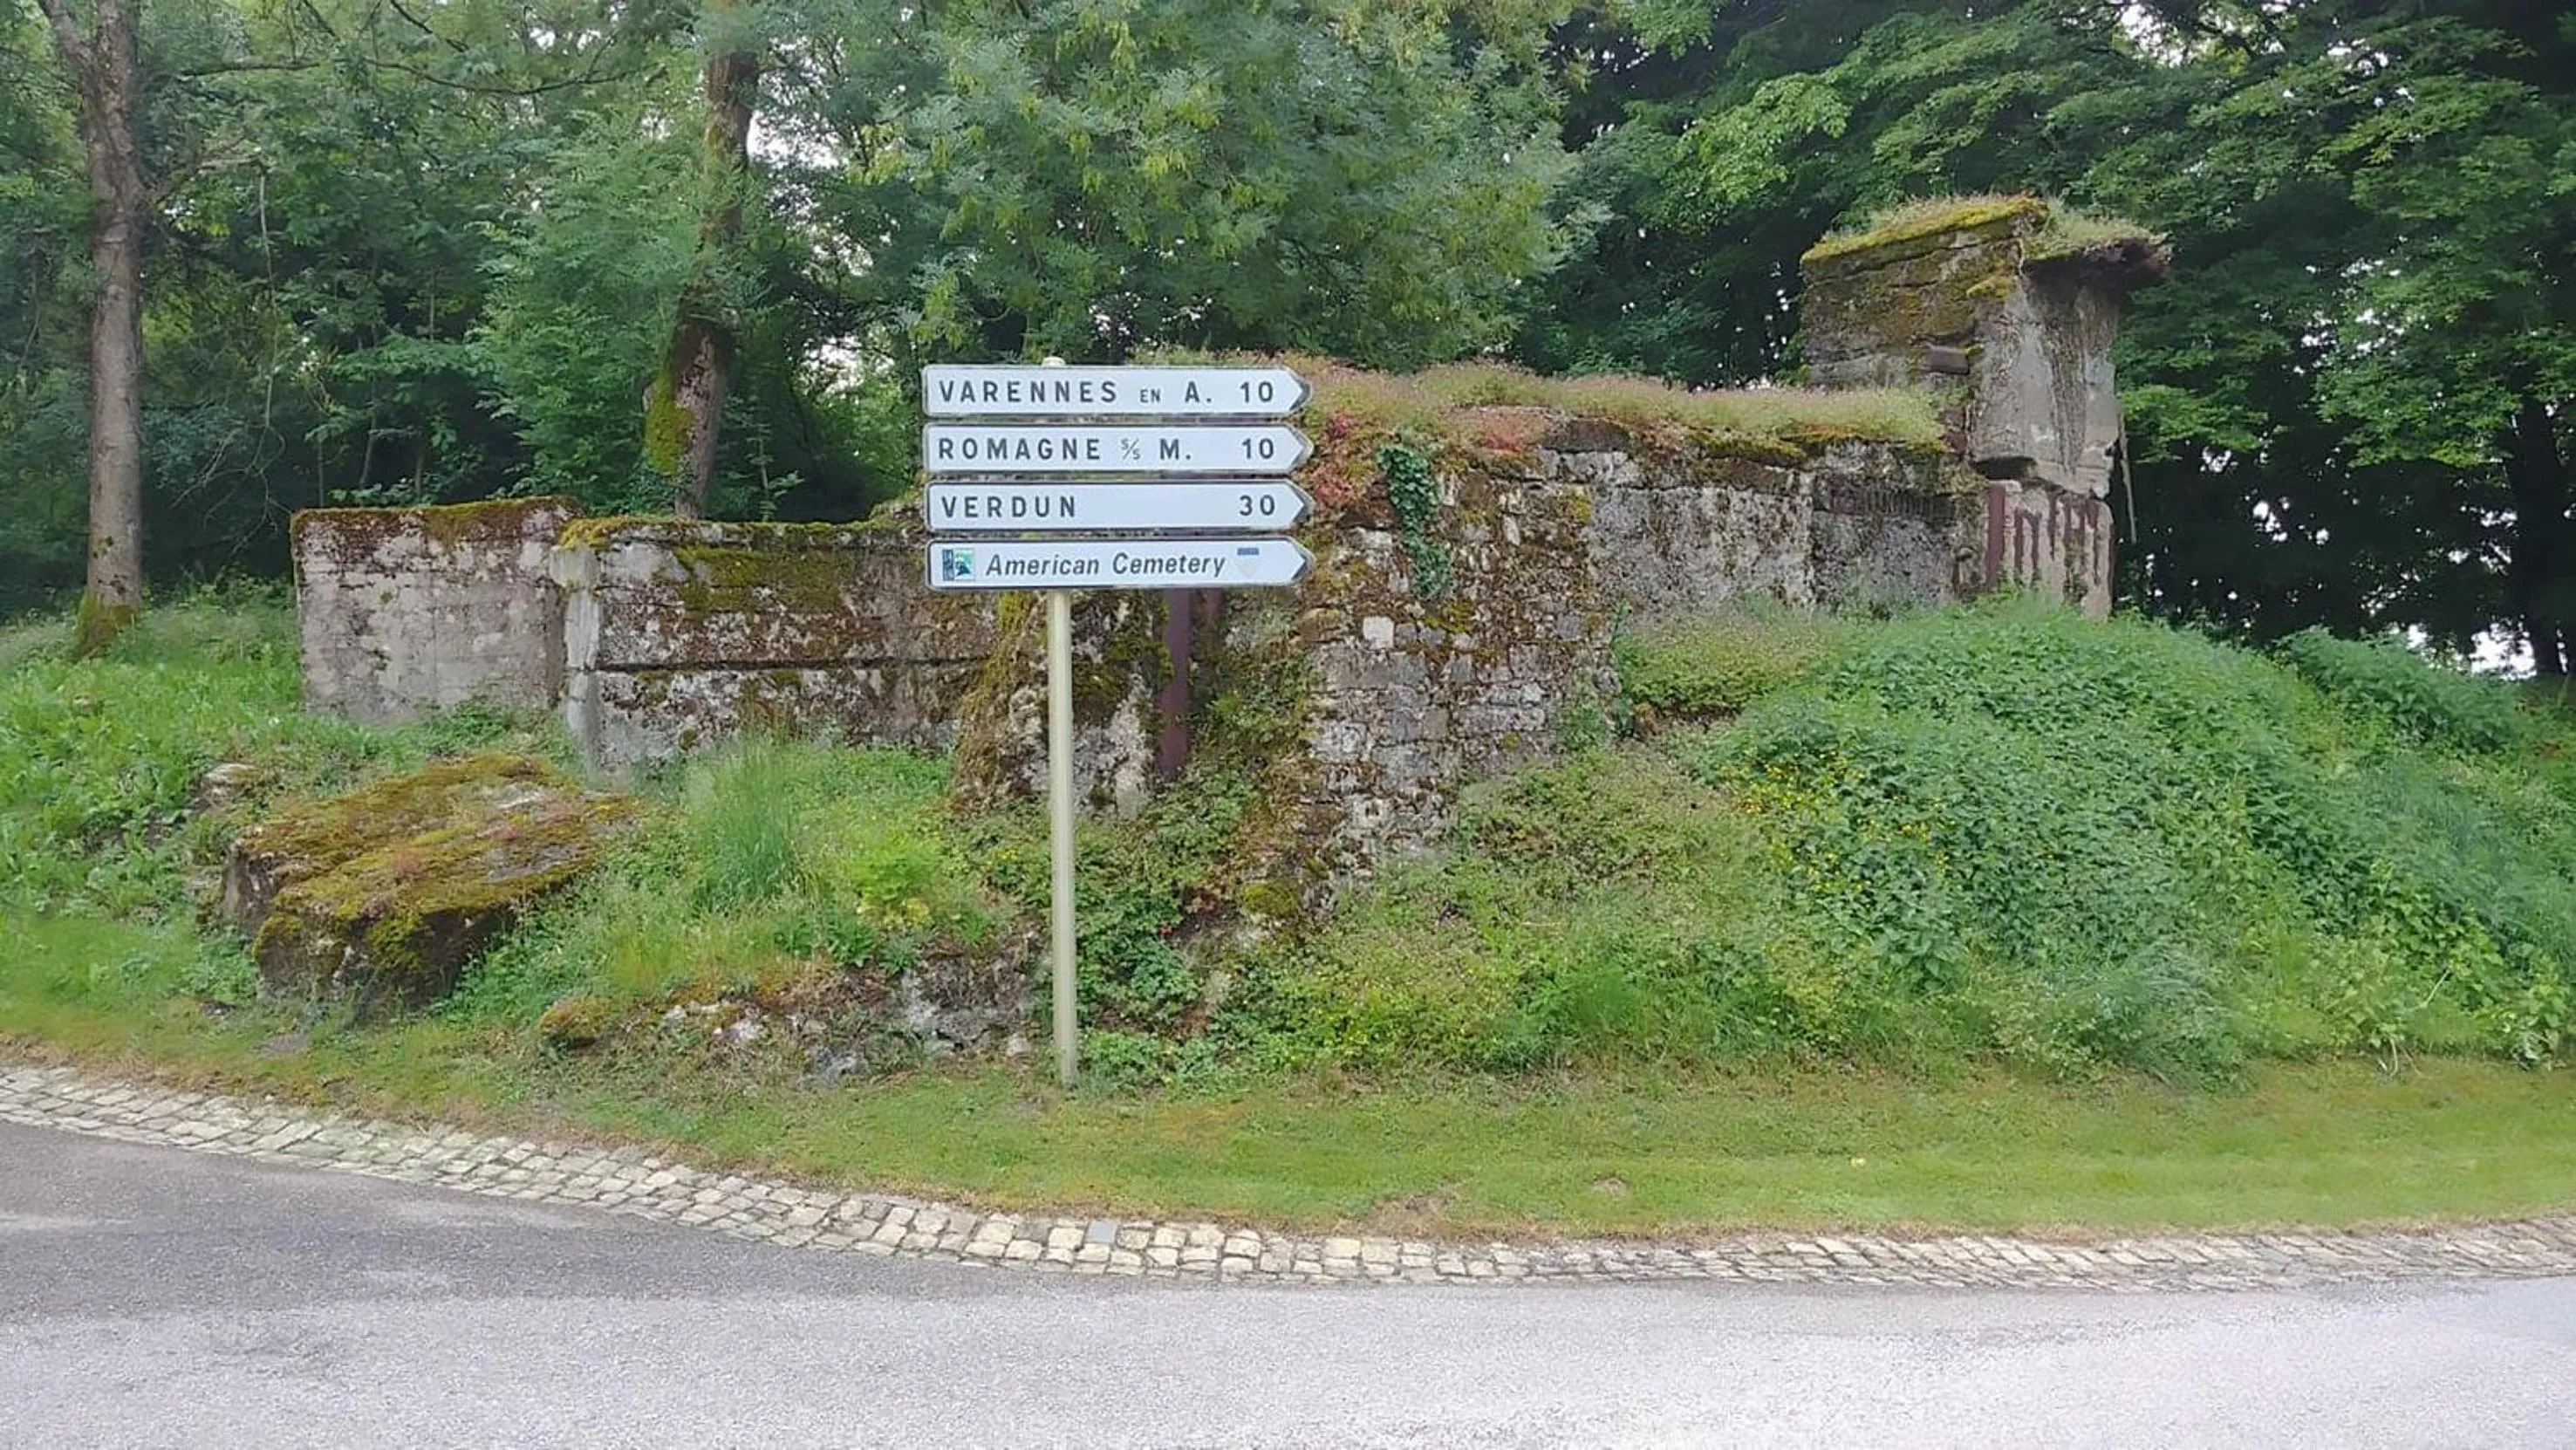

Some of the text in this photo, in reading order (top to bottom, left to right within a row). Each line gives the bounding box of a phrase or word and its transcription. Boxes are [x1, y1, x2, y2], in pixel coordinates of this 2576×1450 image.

[939, 380, 1274, 403] VARENNES EN A. 10
[939, 437, 1101, 461] ROMAGNE
[1159, 438, 1192, 461] M.
[1241, 438, 1274, 460] 10
[940, 494, 1275, 518] VERDUN 30
[986, 552, 1227, 579] American Cemetery
